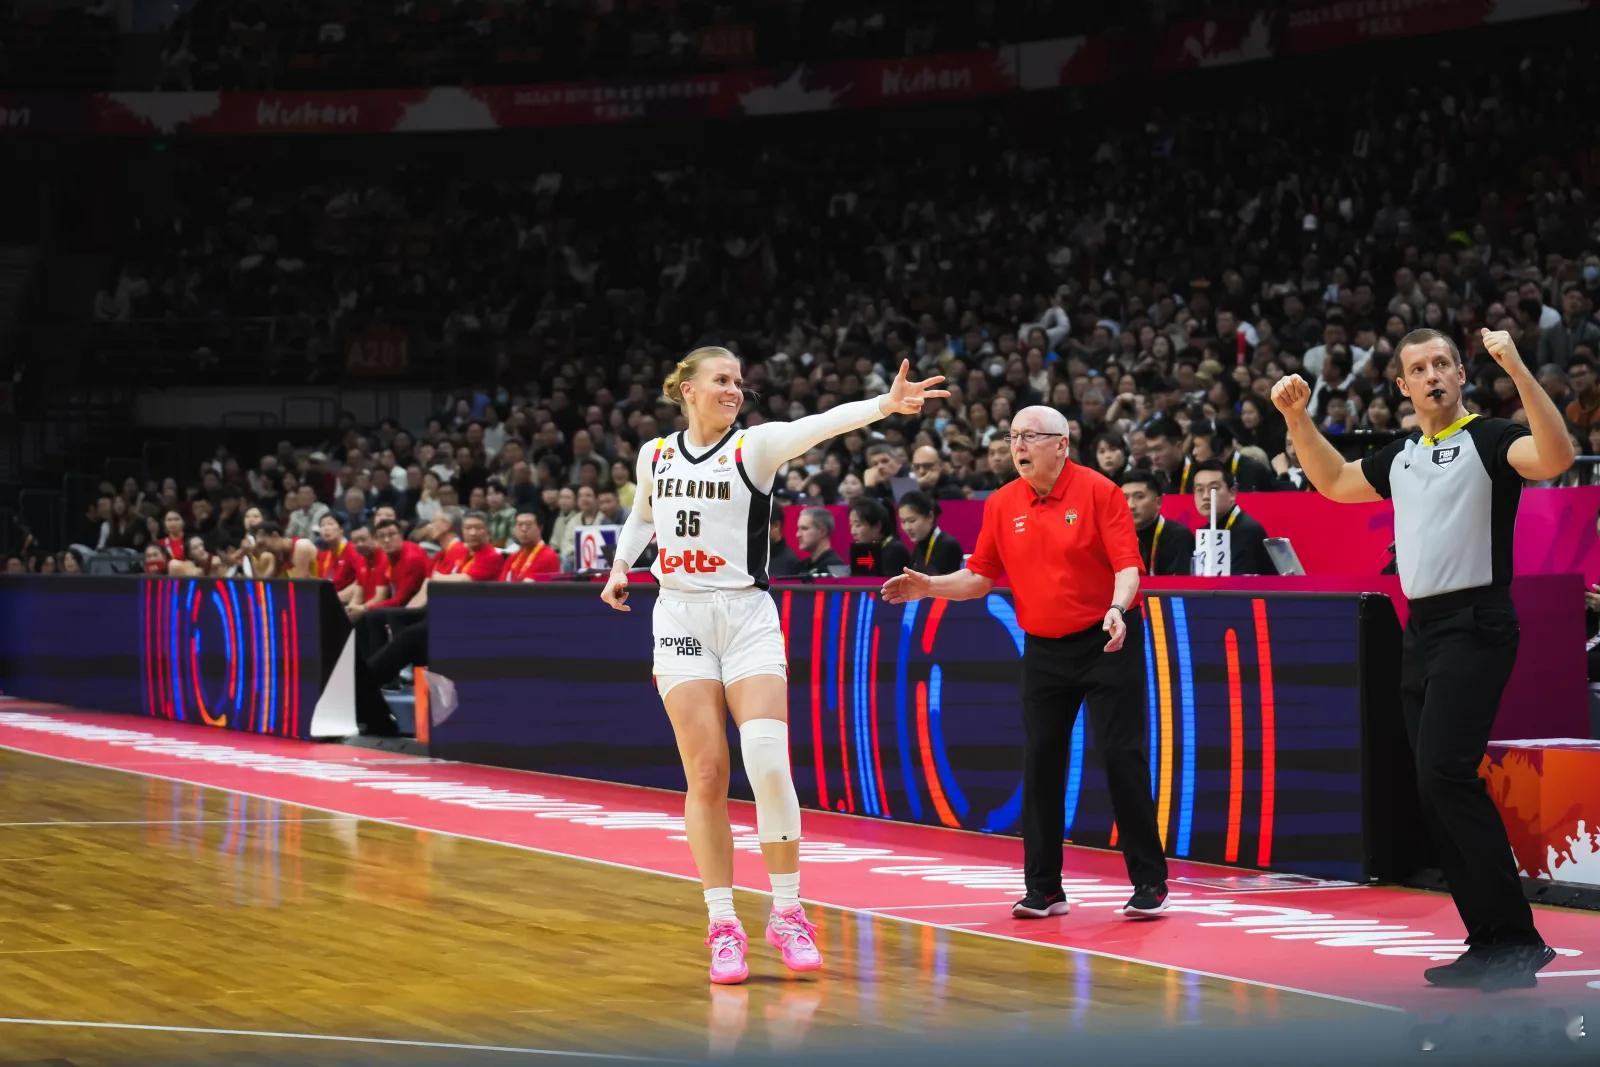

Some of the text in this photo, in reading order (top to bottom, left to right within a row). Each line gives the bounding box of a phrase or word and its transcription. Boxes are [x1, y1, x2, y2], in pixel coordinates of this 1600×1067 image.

[882, 66, 972, 95] Wuhan
[256, 100, 359, 126] Wuhan
[1439, 449, 1455, 458] FIBA
[657, 478, 731, 500] BELGIUM
[676, 510, 701, 538] 35
[1216, 532, 1224, 546] 3
[659, 548, 727, 574] Lotto
[1216, 551, 1225, 565] 2
[660, 637, 702, 648] POWER
[676, 646, 703, 656] ADE
